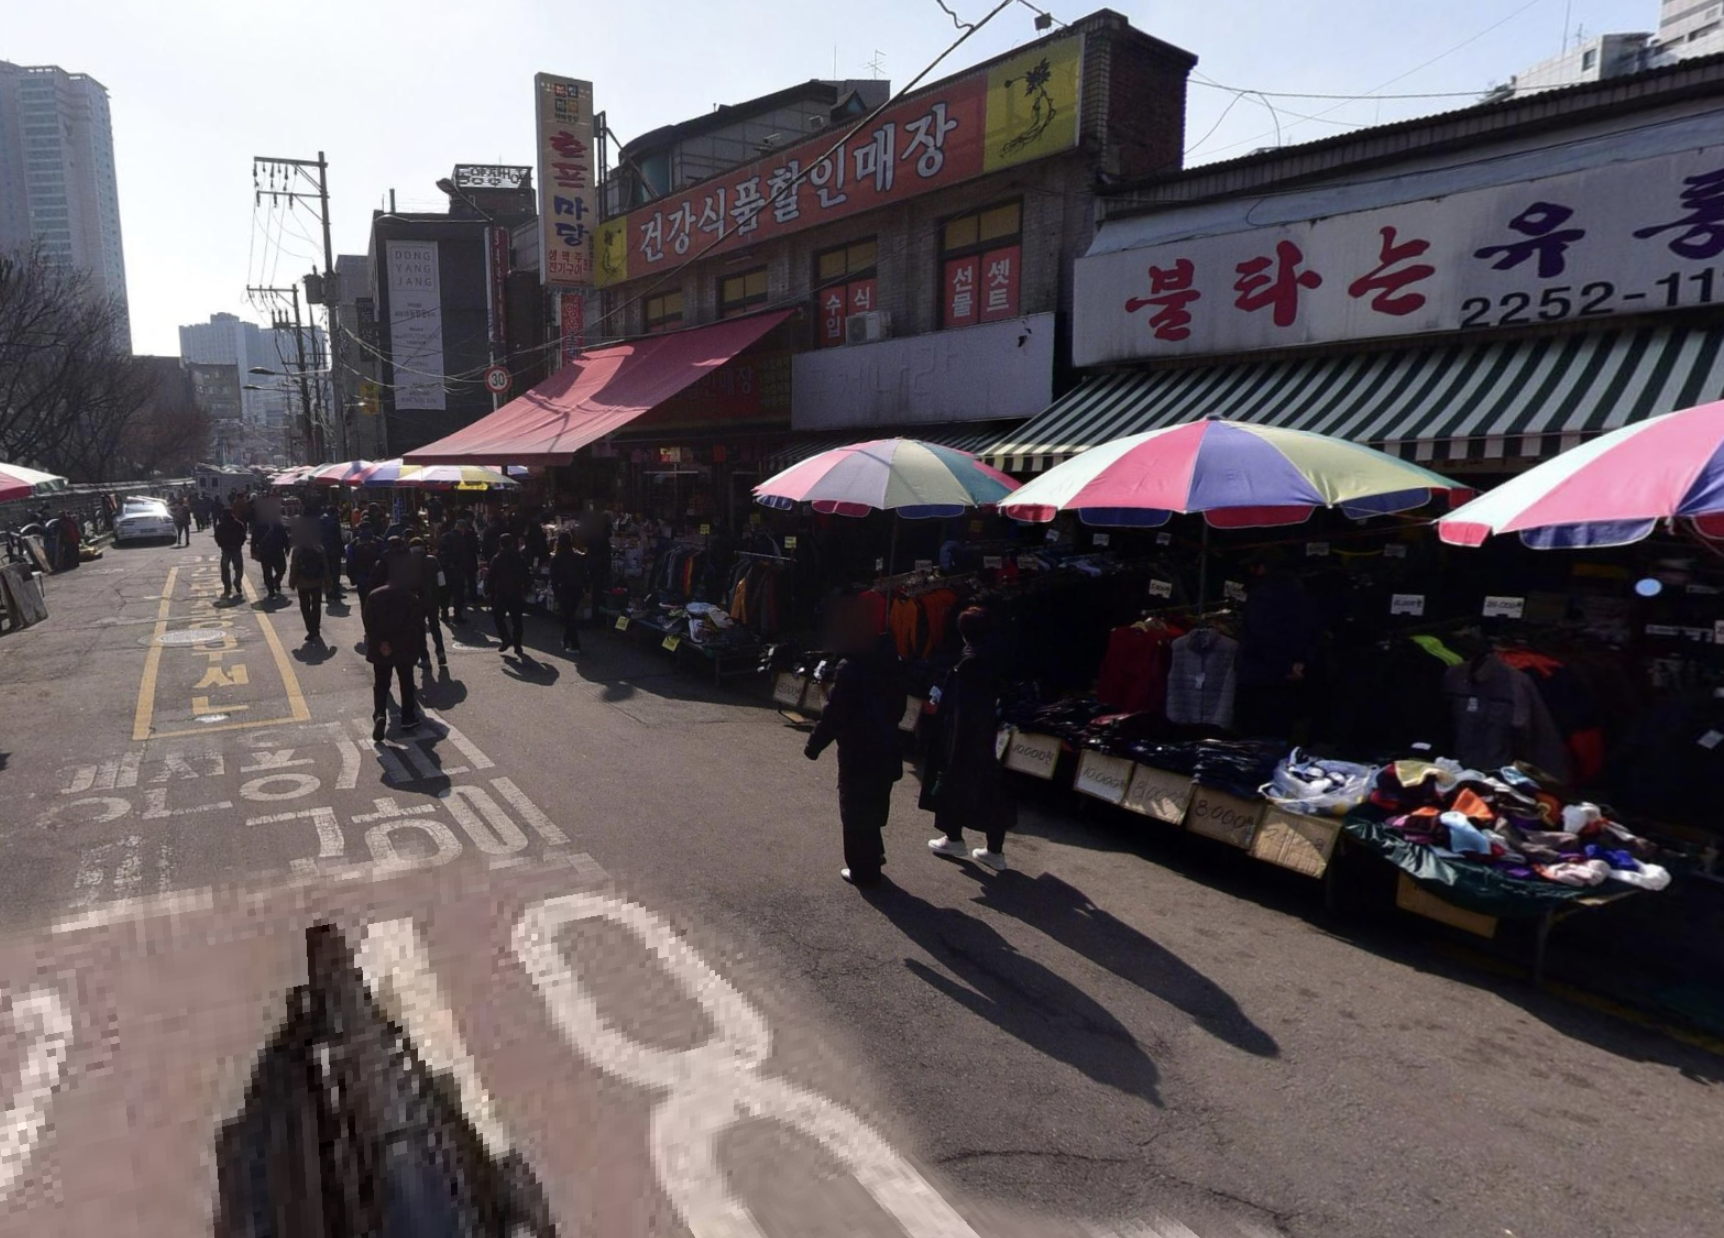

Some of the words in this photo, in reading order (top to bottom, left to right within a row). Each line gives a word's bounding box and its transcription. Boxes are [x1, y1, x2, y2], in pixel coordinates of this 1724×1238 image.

[639, 102, 957, 263] 건강식품할인매장
[394, 250, 431, 260] DONG
[395, 263, 432, 273] YANG
[396, 277, 433, 287] JANG
[952, 265, 974, 319] 선물
[986, 258, 1011, 313] 셋트
[1125, 225, 1436, 342] 불타는
[1458, 267, 1724, 331] 2252-11
[825, 294, 842, 340] 수입
[491, 373, 506, 388] 30
